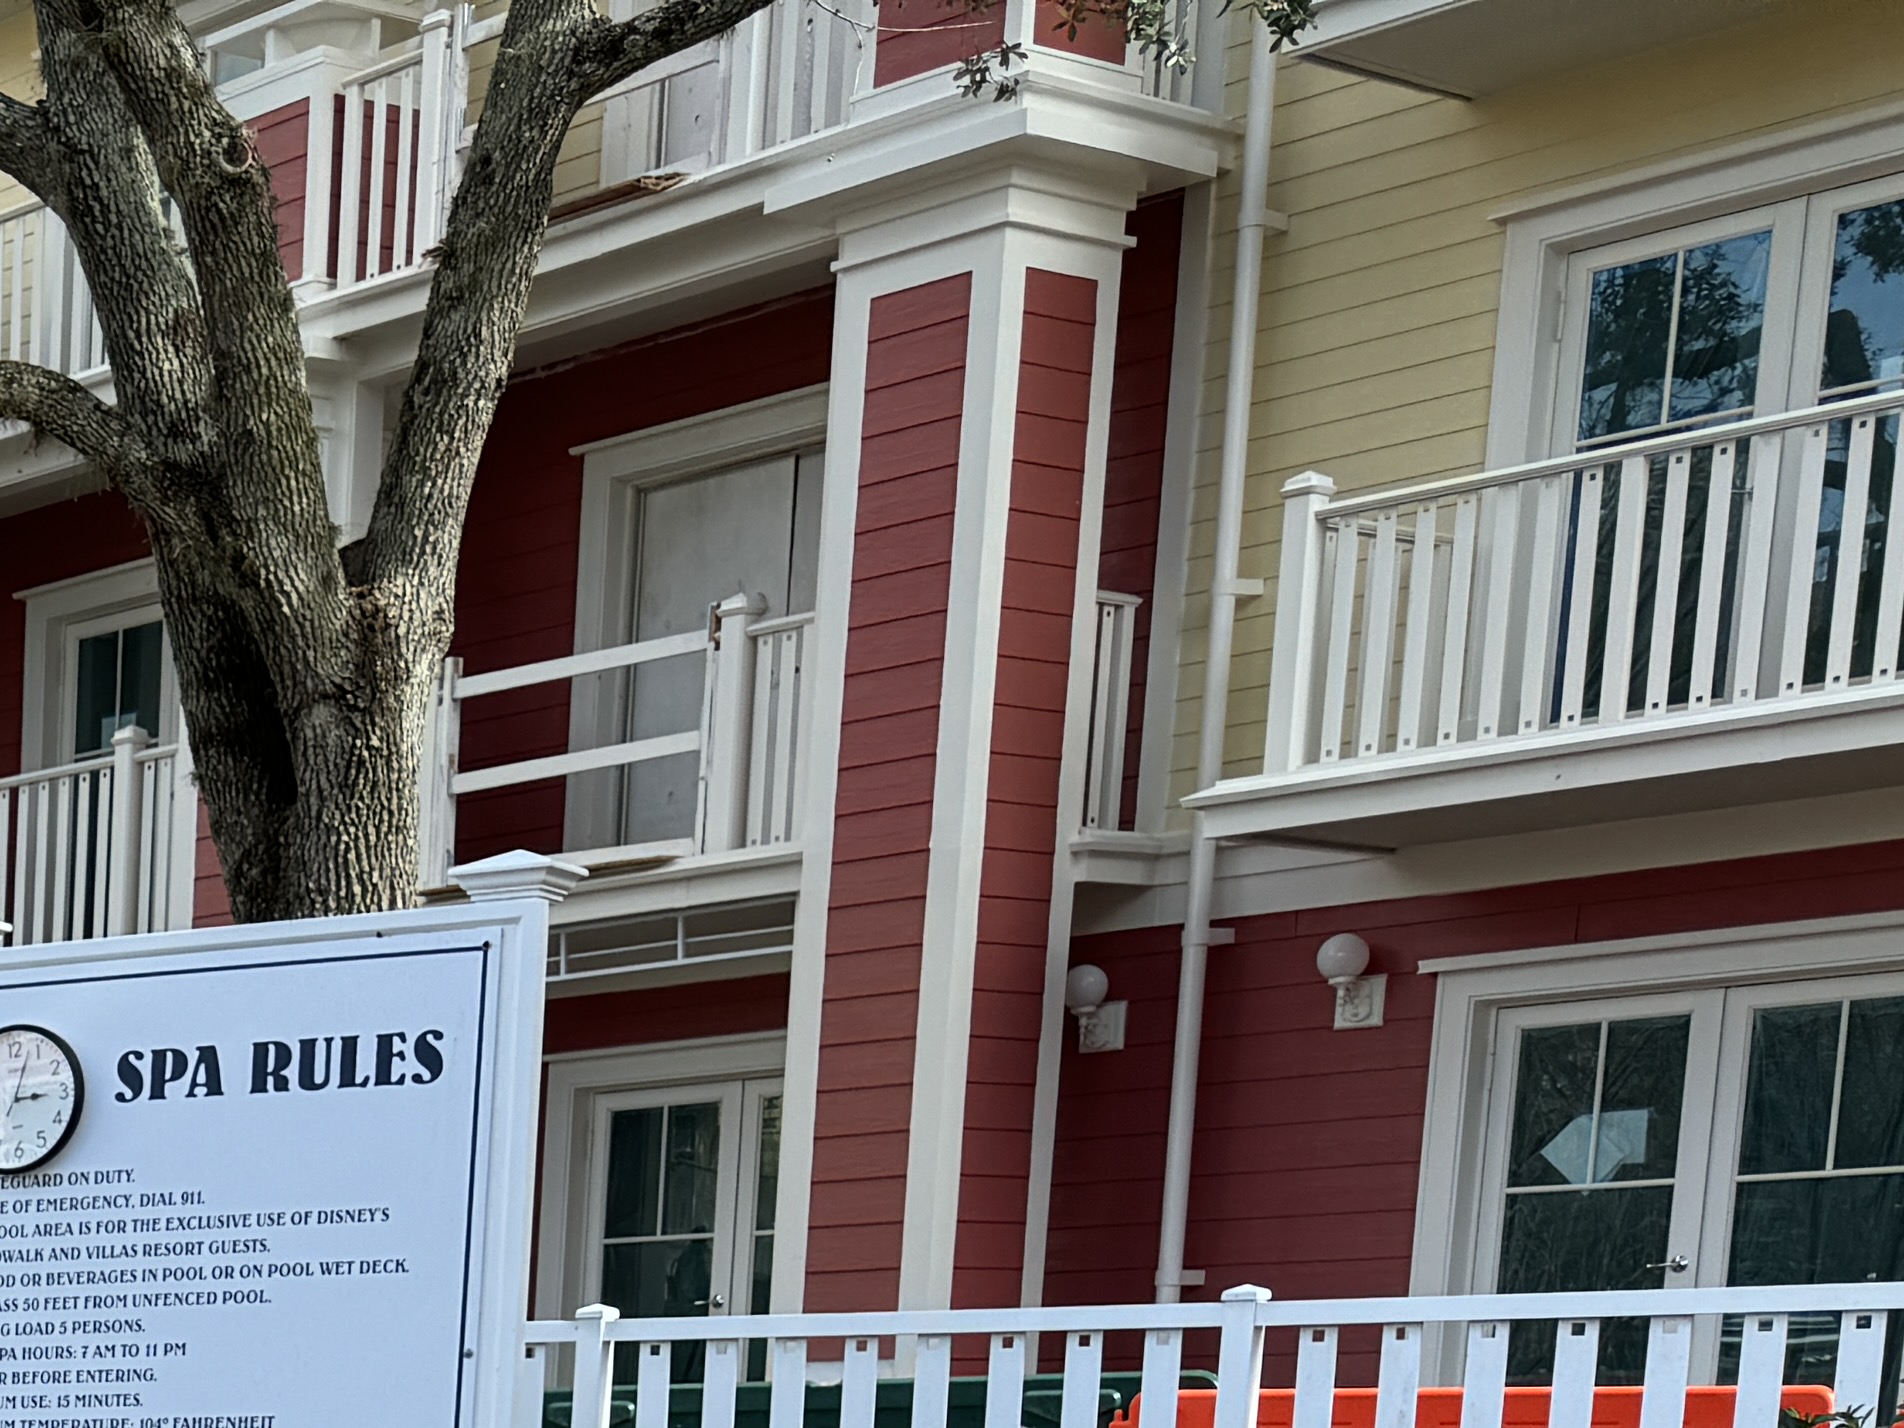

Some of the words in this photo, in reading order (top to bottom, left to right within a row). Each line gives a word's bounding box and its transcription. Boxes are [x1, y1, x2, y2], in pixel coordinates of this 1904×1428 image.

[7, 1041, 22, 1059] 12
[49, 1059, 61, 1076] 2
[114, 1044, 225, 1104] SPA
[248, 1028, 445, 1095] RULES
[59, 1082, 70, 1100] 3
[52, 1110, 63, 1125] 4
[36, 1130, 48, 1149] 5
[13, 1140, 25, 1159] 6
[67, 1171, 91, 1186] ON
[93, 1168, 136, 1185] DUTY.
[11, 1198, 33, 1214] OF
[35, 1193, 136, 1213] EMERGENCY,
[139, 1191, 178, 1208] DIAL
[180, 1190, 206, 1206] 911.
[31, 1221, 74, 1238] AREA
[78, 1220, 92, 1236] IS
[95, 1219, 127, 1235] FOR
[130, 1217, 162, 1234] THE
[164, 1212, 253, 1232] EXCLUSIVE
[256, 1211, 287, 1228] USE
[290, 1210, 314, 1226] OF
[316, 1207, 390, 1225] DISNEY'S
[47, 1246, 82, 1263] AND
[85, 1243, 138, 1260] VILLAS
[142, 1240, 205, 1258] RESORT
[207, 1238, 271, 1255] GUESTS.
[19, 1272, 42, 1288] OR
[45, 1268, 138, 1287] BEVERAGES
[141, 1267, 159, 1283] IN
[161, 1266, 208, 1283] POOL
[211, 1264, 235, 1281] OR
[238, 1263, 264, 1280] ON
[267, 1261, 315, 1279] POOL
[318, 1260, 356, 1276] WET
[359, 1258, 410, 1275] DECK.
[22, 1297, 40, 1312] 50
[43, 1295, 81, 1312] FEET
[83, 1293, 128, 1310] FROM
[132, 1290, 218, 1308] UNFENCED
[221, 1289, 272, 1305] POOL.
[14, 1321, 56, 1337] LOAD
[58, 1320, 68, 1336] 5
[71, 1318, 146, 1335] PERSONS.
[21, 1345, 77, 1361] HOURS:
[80, 1344, 90, 1360] 7
[92, 1343, 117, 1359] AM
[119, 1343, 140, 1358] TO
[145, 1342, 158, 1358] 11
[163, 1342, 187, 1357] PM
[11, 1369, 73, 1385] BEFORE
[75, 1367, 158, 1384] ENTERING.
[20, 1394, 52, 1410] USE:
[56, 1394, 71, 1409] 15
[74, 1392, 144, 1409] MINUTES.
